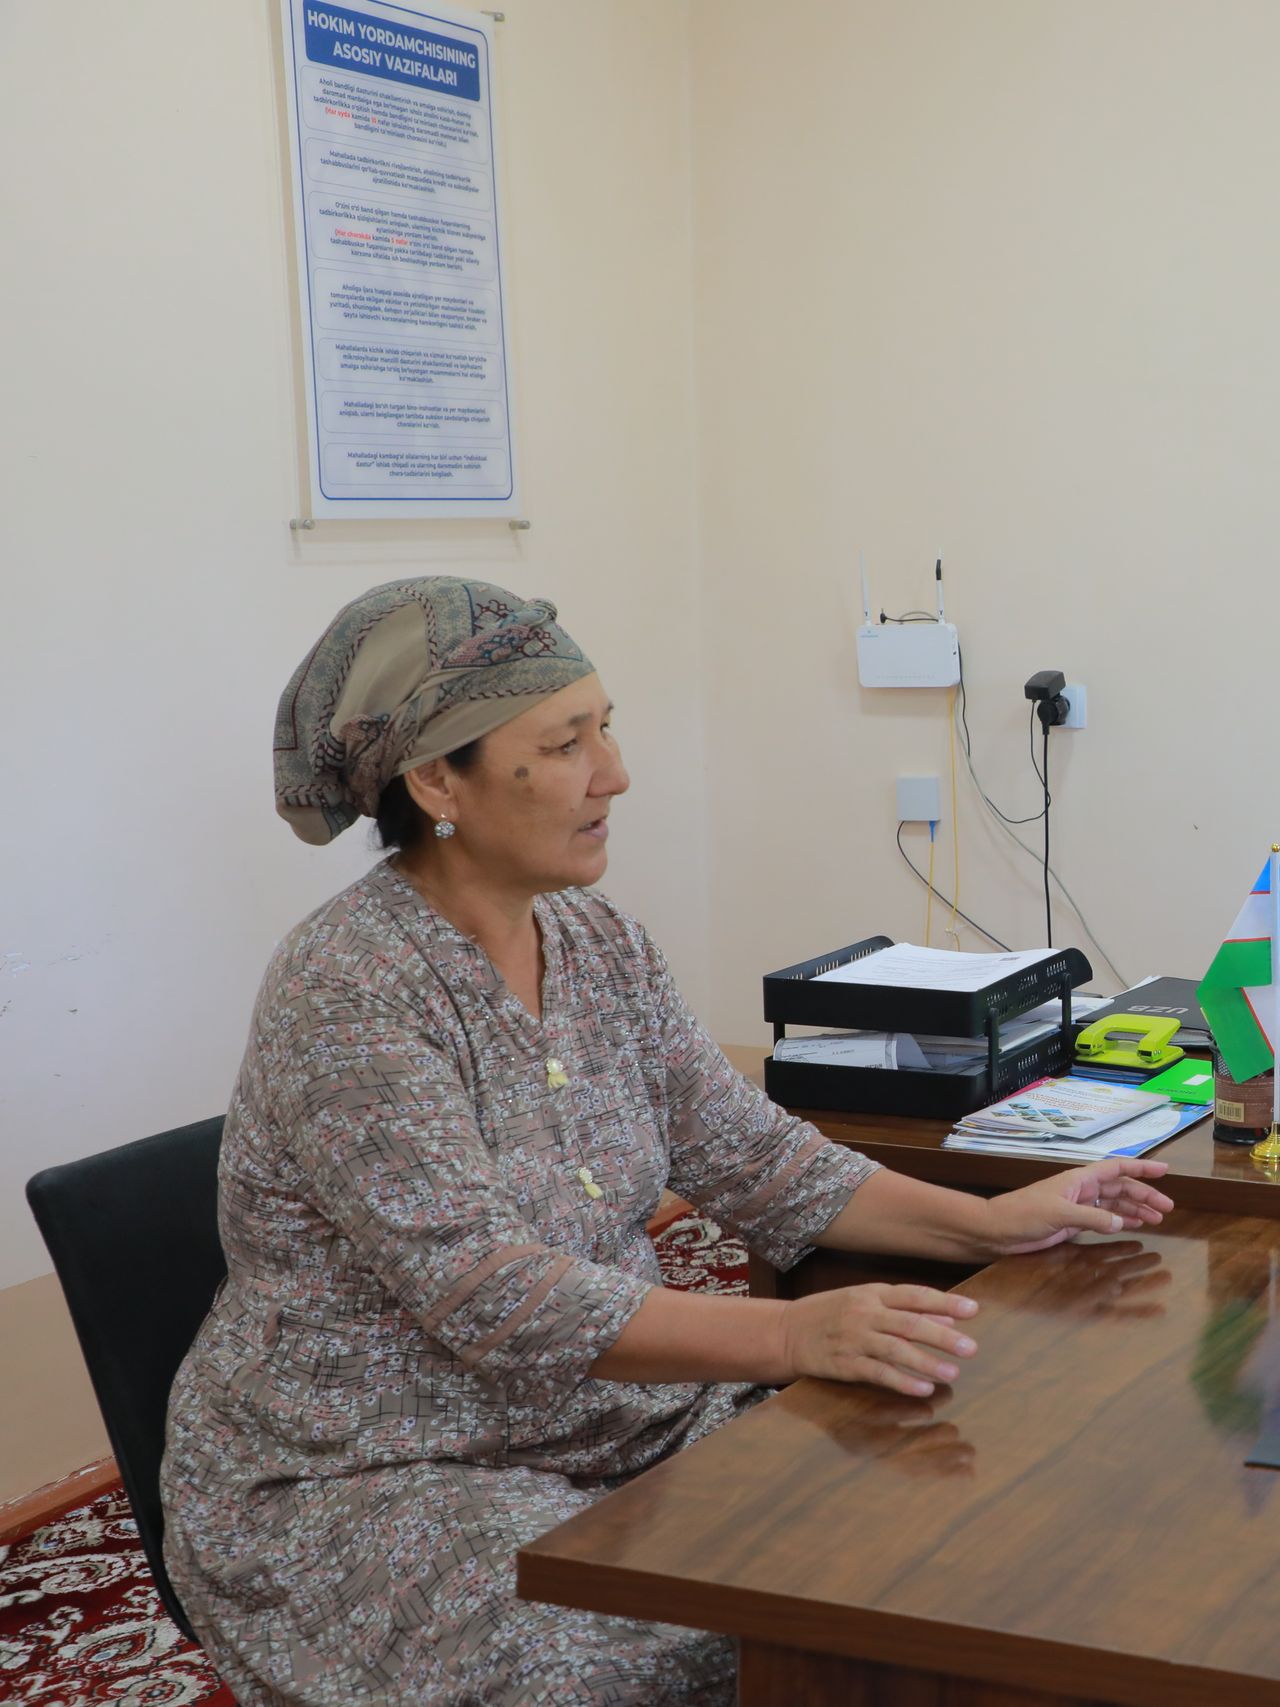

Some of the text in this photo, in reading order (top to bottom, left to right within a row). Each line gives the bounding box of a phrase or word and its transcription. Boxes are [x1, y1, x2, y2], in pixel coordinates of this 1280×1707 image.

[307, 9, 477, 69] HOKIM YORDAMCHISINING
[332, 41, 458, 87] ASOSIY VAZIFALARI
